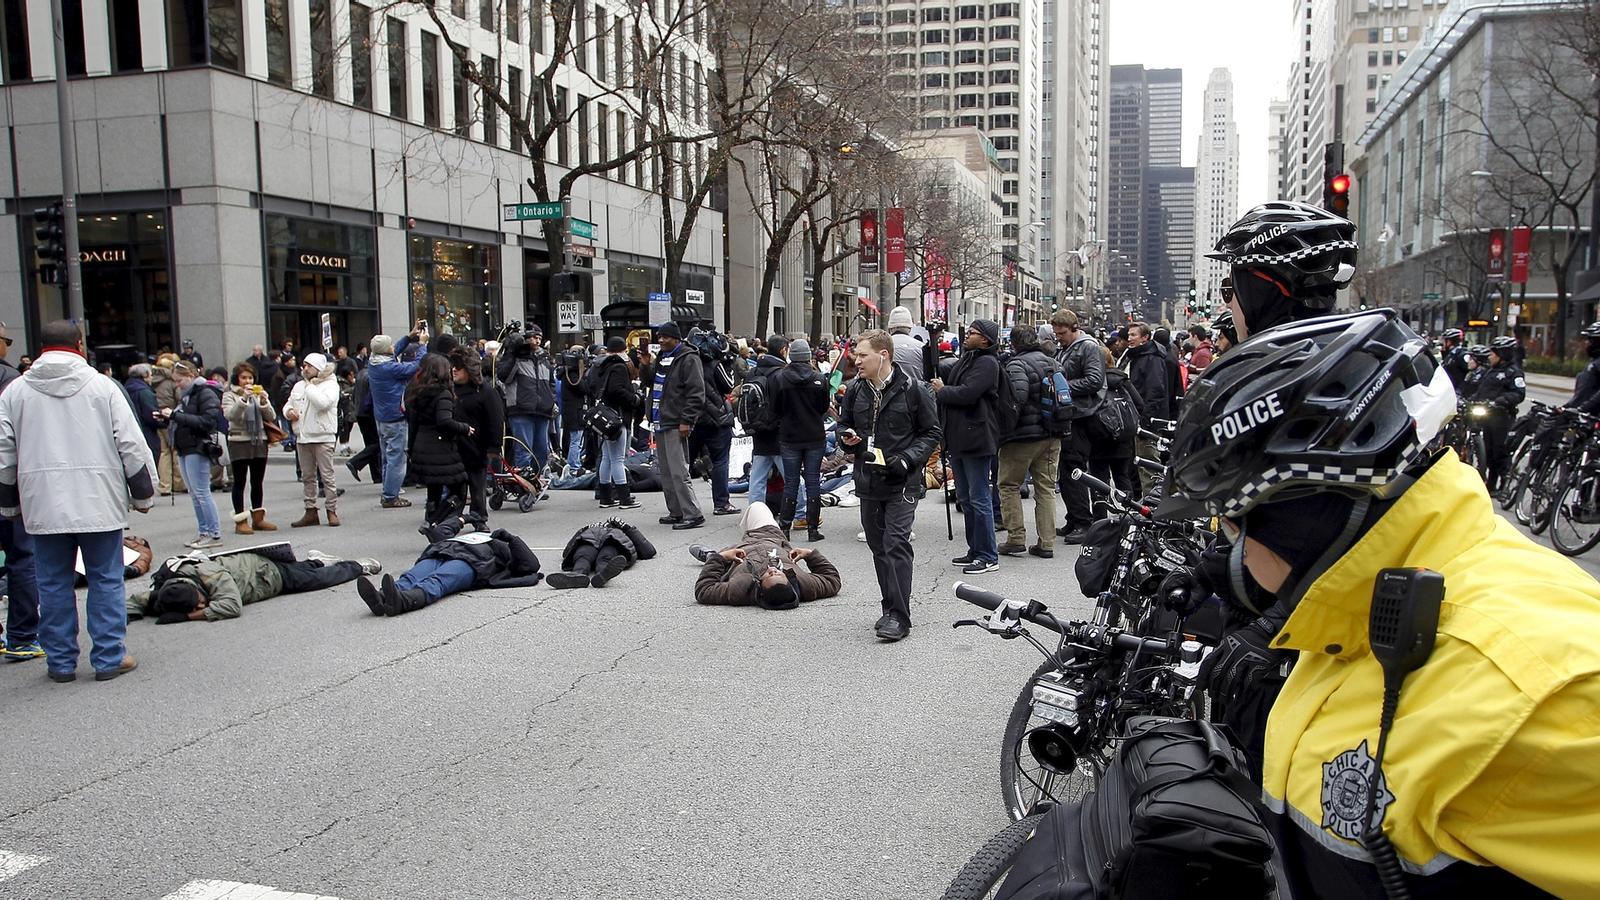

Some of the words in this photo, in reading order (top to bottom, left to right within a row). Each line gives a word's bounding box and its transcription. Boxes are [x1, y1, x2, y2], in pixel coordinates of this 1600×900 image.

[523, 205, 553, 216] Ontario
[1251, 223, 1288, 249] POLICE
[79, 249, 126, 264] OACH
[300, 253, 347, 269] COACH
[560, 303, 577, 312] ONE
[560, 312, 577, 320] WAY
[1348, 369, 1393, 422] BONTRAGER
[1211, 392, 1284, 445] POLICE
[1328, 753, 1385, 800] CHICAO
